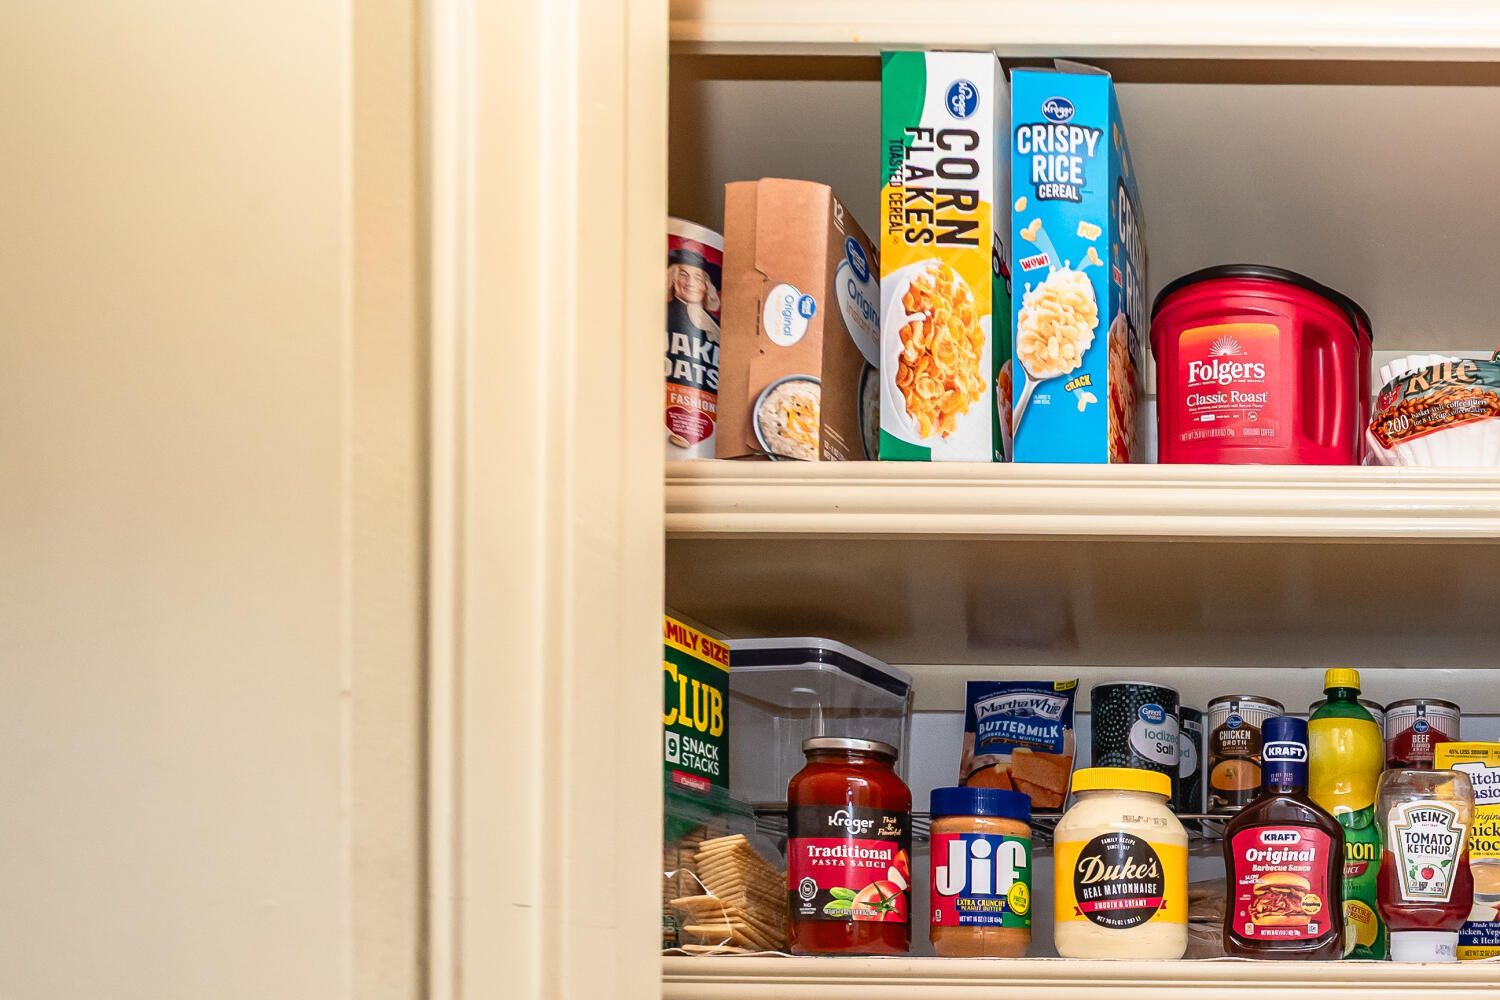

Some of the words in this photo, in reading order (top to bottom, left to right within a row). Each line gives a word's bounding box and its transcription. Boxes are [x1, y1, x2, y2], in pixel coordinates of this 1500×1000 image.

[1044, 101, 1073, 117] Kroger
[1017, 124, 1101, 157] CRISPY
[888, 138, 903, 188] TOASTED
[1033, 155, 1083, 184] RICE
[904, 127, 934, 245] FLAKES
[936, 129, 979, 246] CORN
[1039, 184, 1078, 200] CEREAL
[888, 192, 903, 235] CEREAL
[1080, 224, 1101, 239] POP
[1022, 256, 1049, 271] WOW!
[784, 295, 794, 337] Original
[1188, 359, 1266, 385] Folgers
[1065, 375, 1092, 391] CRACK
[1186, 391, 1228, 407] Classic
[1230, 390, 1267, 403] Roast
[1387, 415, 1409, 436] 200
[702, 638, 729, 667] SIZE
[664, 661, 723, 737] CLUB
[981, 700, 1028, 716] Martha
[1142, 707, 1162, 717] Great
[979, 721, 1059, 738] BUTTERMILK
[1219, 729, 1251, 740] CHICKEN
[668, 737, 677, 757] 9
[682, 735, 719, 761] SNACK
[1156, 742, 1174, 756] Salt
[1268, 747, 1302, 757] KRAFT
[682, 752, 720, 776] STACKS
[828, 809, 874, 835] Kroger
[1411, 812, 1449, 826] HEINZ
[1264, 833, 1297, 841] KRAFT
[1405, 832, 1452, 846] TOMATO
[807, 845, 892, 861] Traditional
[1245, 847, 1315, 865] Original
[1407, 844, 1450, 855] KETCHUP
[812, 859, 845, 867] PASTA
[851, 859, 886, 869] SAUCE
[936, 839, 1026, 896] Jif
[1078, 855, 1159, 883] Duke's
[1252, 864, 1287, 872] Barbecue
[1288, 864, 1311, 872] Sauce
[1083, 887, 1102, 900] REAL
[1104, 883, 1157, 896] MAYONNAISE
[957, 899, 976, 907] EXTRA
[977, 899, 1006, 907] CRUNCHY
[1094, 902, 1118, 910] SMOOTH
[1125, 899, 1147, 908] CREAMY
